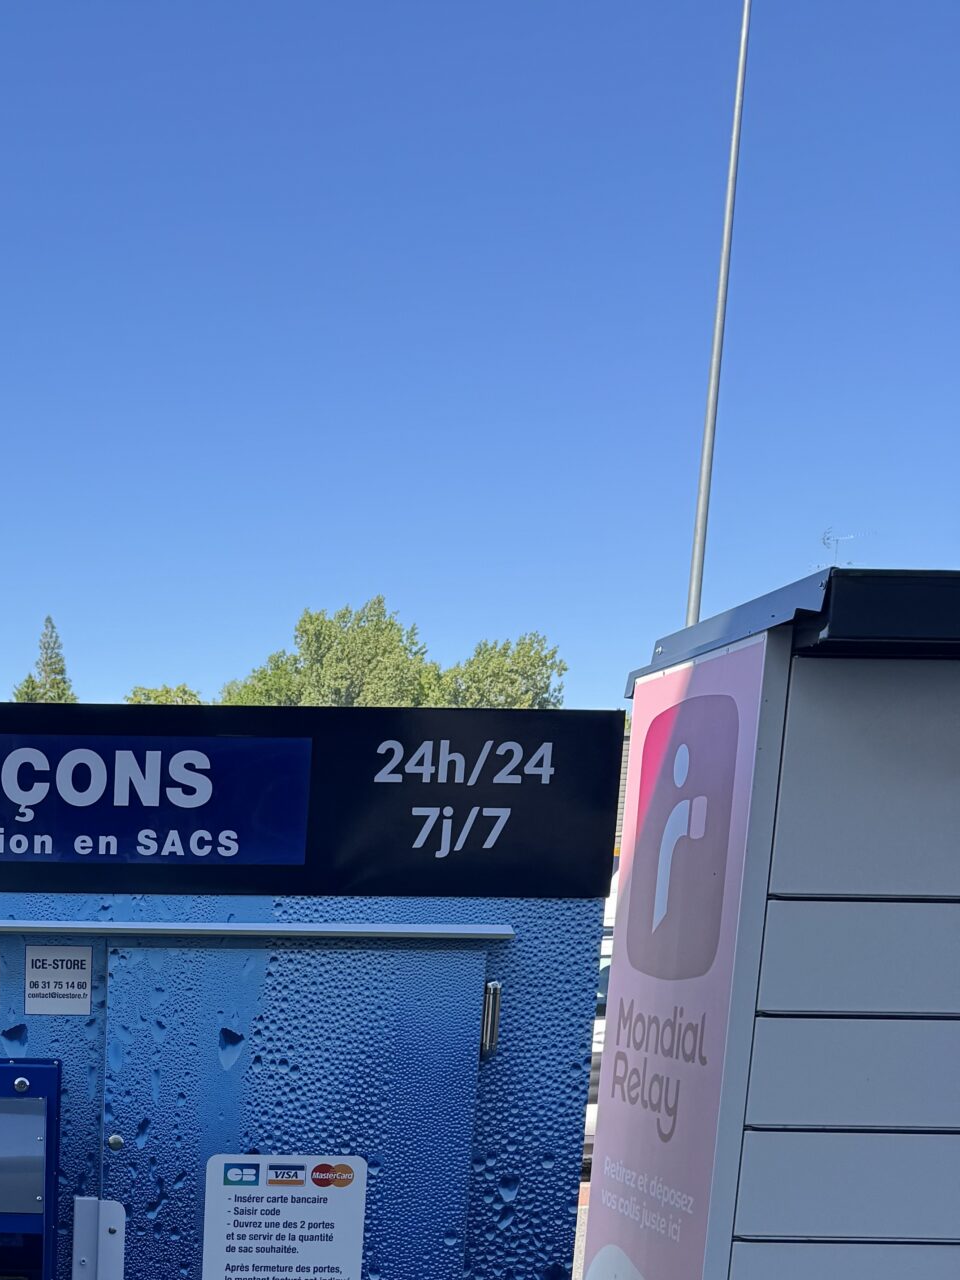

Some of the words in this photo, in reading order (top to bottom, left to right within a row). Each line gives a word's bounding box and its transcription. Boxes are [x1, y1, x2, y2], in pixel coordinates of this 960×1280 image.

[373, 739, 555, 786] 24h/24
[411, 806, 512, 858] 7j/7
[73, 834, 118, 855] en
[135, 828, 240, 857] SACS
[31, 958, 87, 970] ICE-STORE
[29, 981, 39, 990] 06
[41, 981, 50, 990] 31
[53, 981, 63, 990] 75
[66, 981, 75, 990] 14
[77, 981, 87, 990] 60
[615, 997, 708, 1067] Mondial
[610, 1050, 681, 1144] Relay
[274, 1171, 299, 1179] VISA
[311, 1171, 354, 1181] MasterCard
[603, 1155, 637, 1189] Retirez
[637, 1172, 648, 1193] et
[649, 1174, 695, 1214] déposez
[234, 1194, 265, 1203] Insérer
[266, 1195, 289, 1204] carte
[290, 1194, 328, 1204] bancaire
[233, 1206, 258, 1216] Saisir
[260, 1207, 281, 1216] code
[601, 1187, 617, 1208] vos
[639, 1202, 667, 1236] juste
[668, 1218, 683, 1243] ici
[233, 1219, 262, 1228] Ouvrez
[264, 1221, 281, 1229] une
[282, 1220, 298, 1229] des
[299, 1220, 306, 1229] 2
[307, 1221, 335, 1231] portes
[226, 1232, 235, 1240] et
[248, 1232, 274, 1241] servir
[275, 1232, 286, 1241] de
[288, 1233, 296, 1241] la
[298, 1233, 334, 1243] quantité
[225, 1244, 236, 1253] de
[255, 1245, 299, 1254] souhaitée.
[224, 1263, 249, 1273] Après
[251, 1264, 293, 1273] fermeture
[295, 1264, 311, 1273] des
[312, 1265, 343, 1275] portes,
